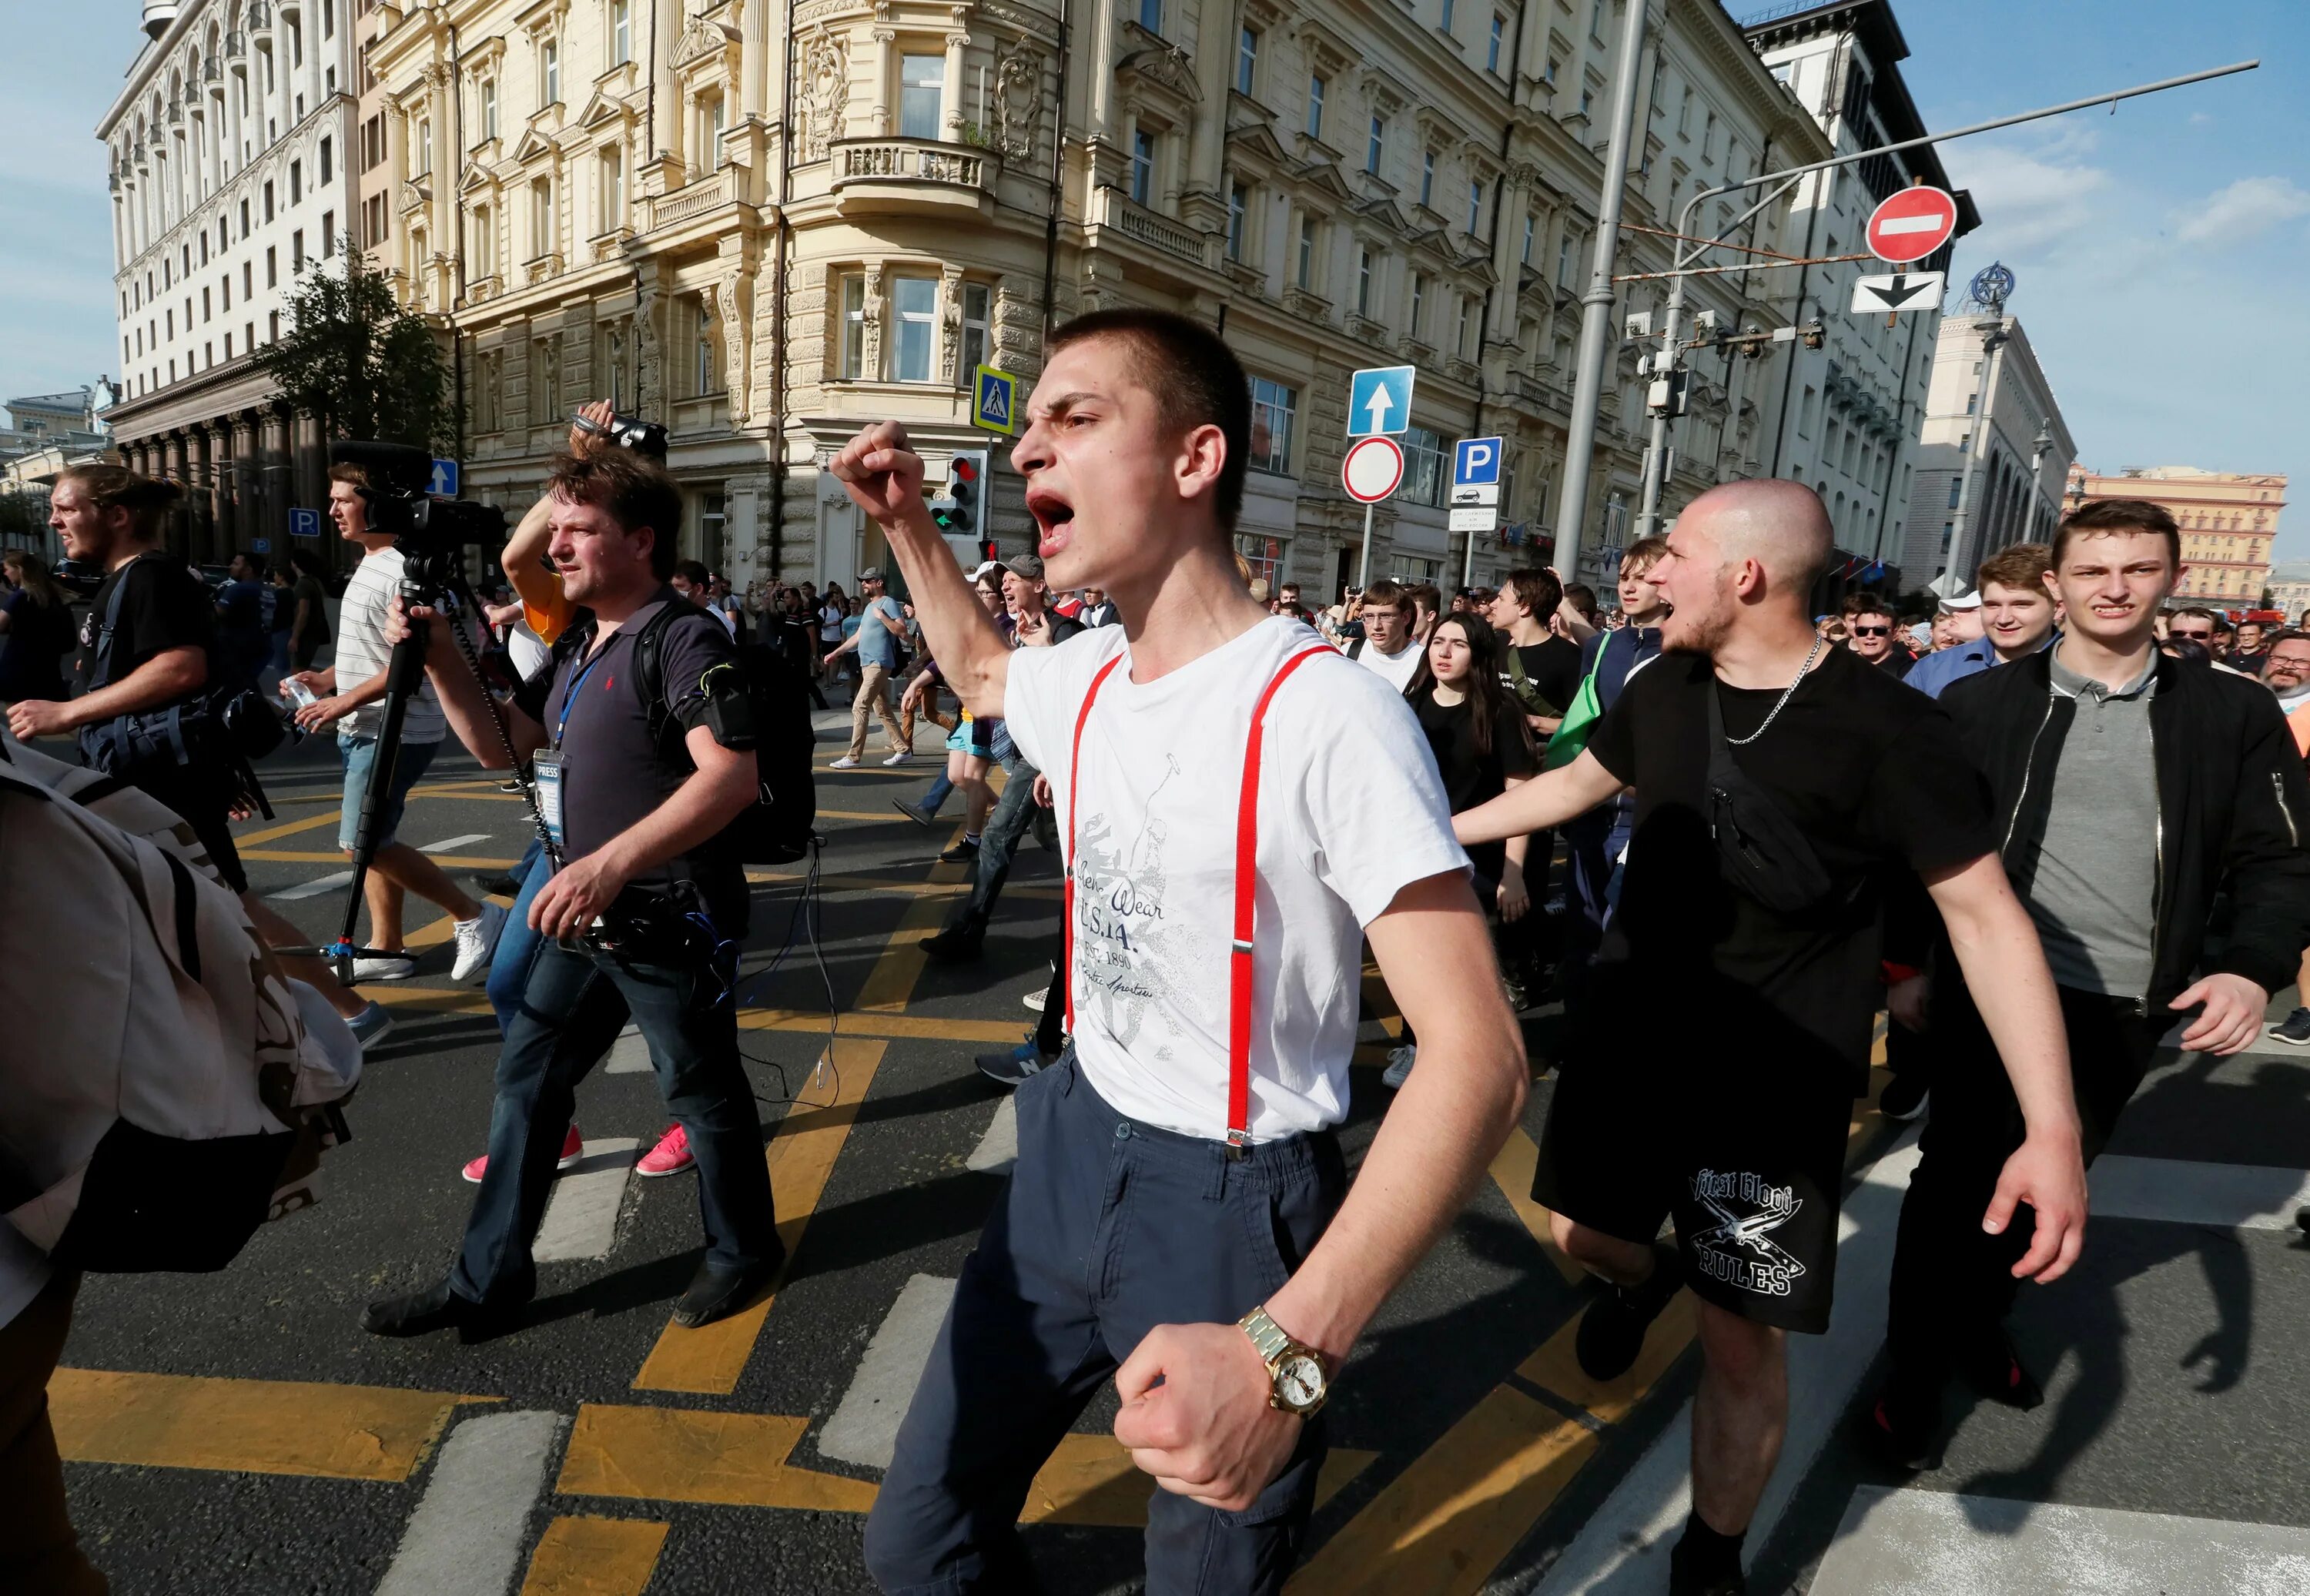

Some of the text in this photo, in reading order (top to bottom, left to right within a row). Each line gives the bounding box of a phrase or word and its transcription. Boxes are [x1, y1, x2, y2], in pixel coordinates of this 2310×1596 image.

[1465, 444, 1491, 480] P
[297, 512, 313, 532] P
[256, 540, 266, 551] P
[537, 765, 558, 778] PRESS
[1111, 876, 1165, 920] Wear
[1106, 951, 1131, 970] 1890
[1019, 1059, 1041, 1076] N
[1697, 1244, 1791, 1296] RULES
